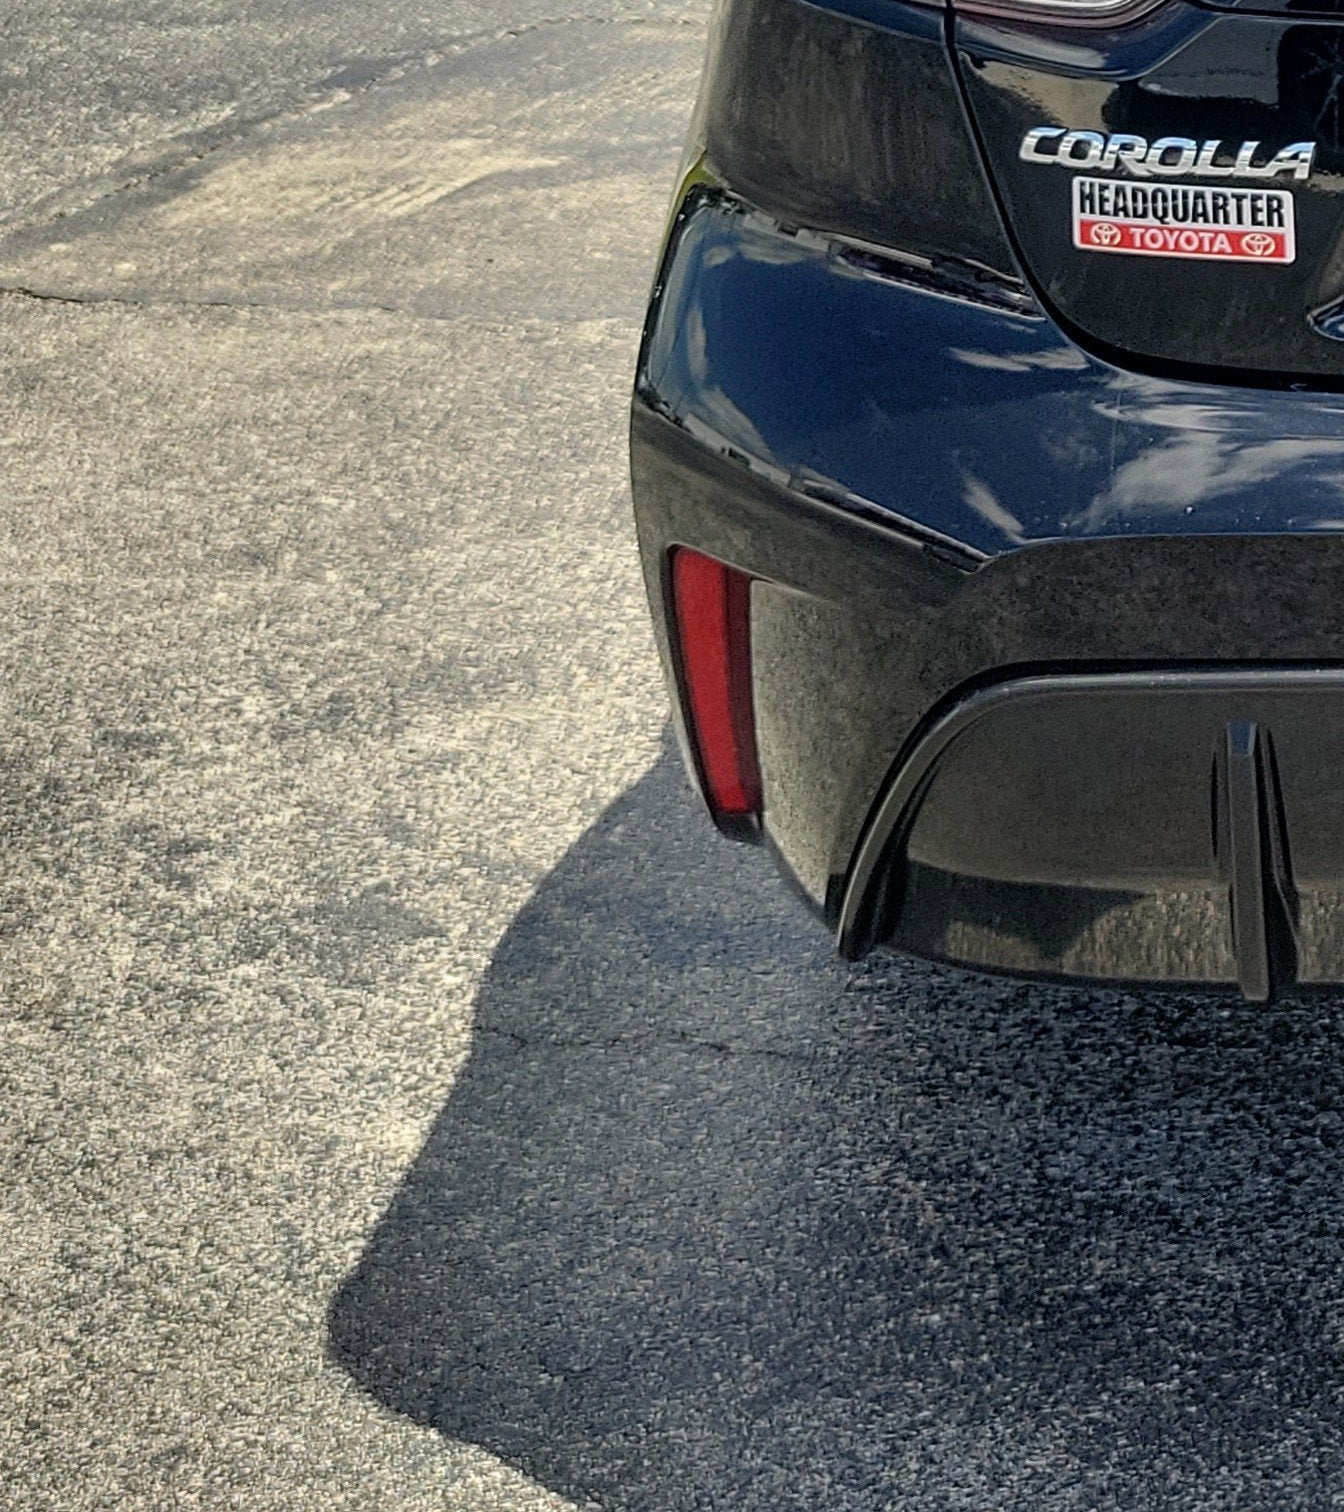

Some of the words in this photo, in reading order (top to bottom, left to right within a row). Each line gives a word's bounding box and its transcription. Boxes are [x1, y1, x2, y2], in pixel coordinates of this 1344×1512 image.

[1019, 126, 1317, 180] COROLLA
[1079, 181, 1286, 228] HEADQUARTER
[1128, 227, 1233, 254] TOYOTA
